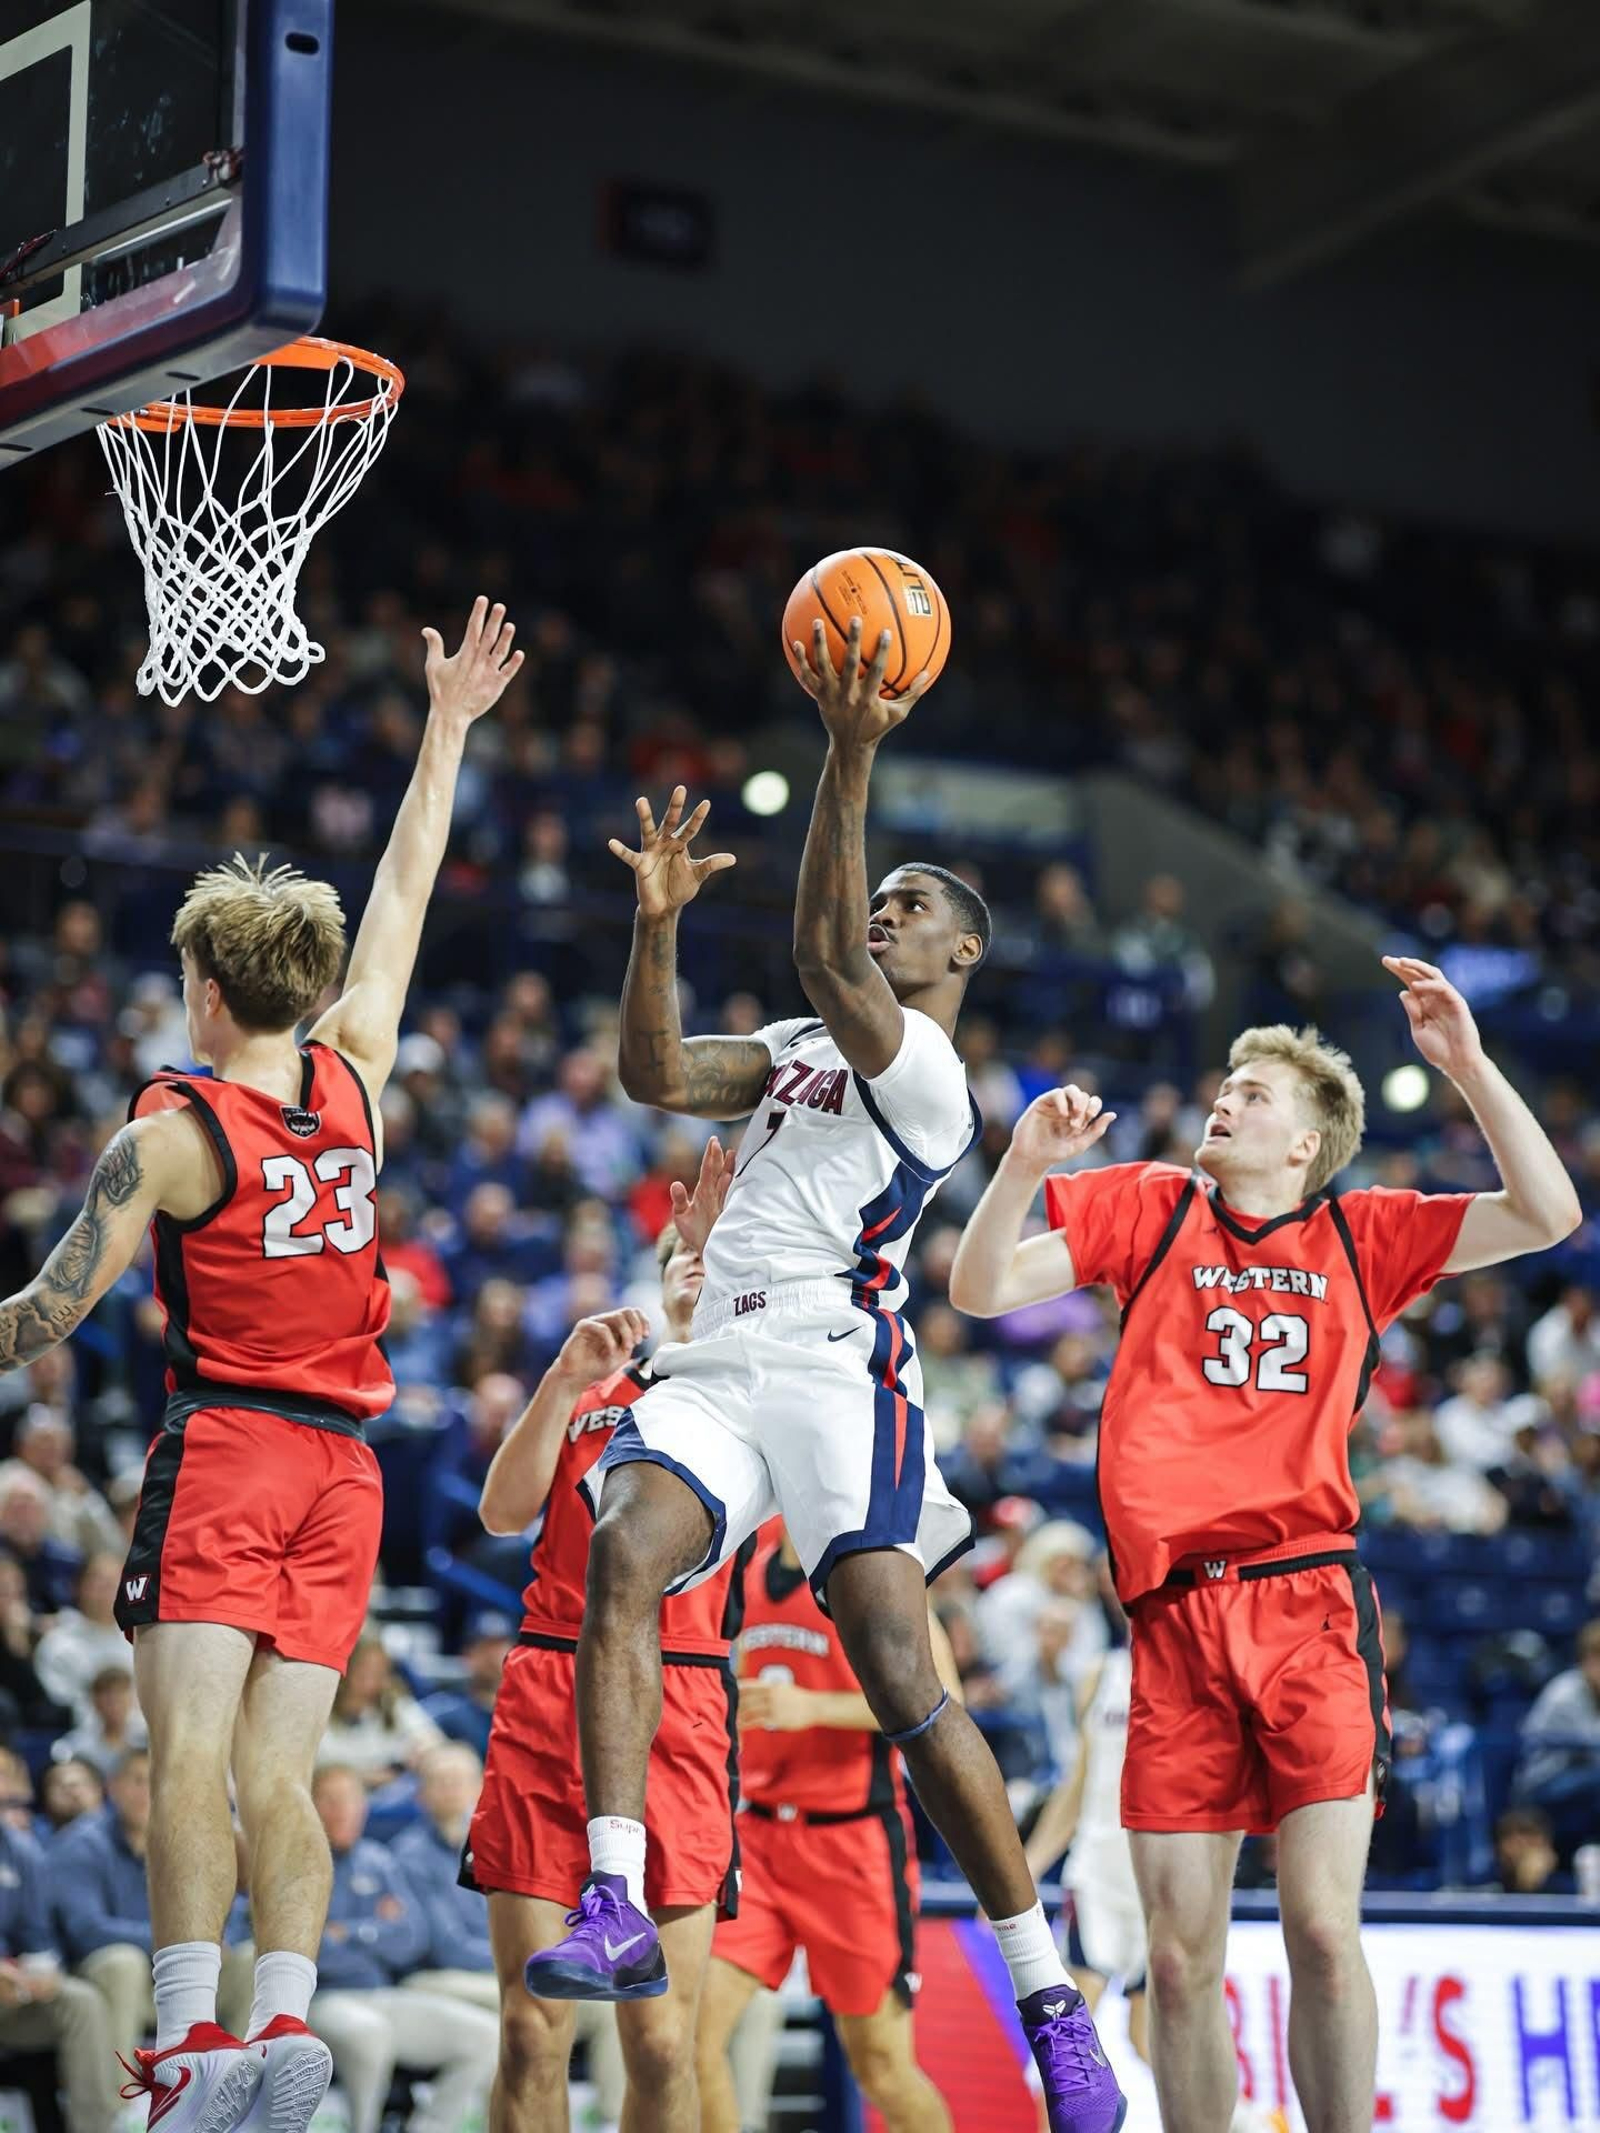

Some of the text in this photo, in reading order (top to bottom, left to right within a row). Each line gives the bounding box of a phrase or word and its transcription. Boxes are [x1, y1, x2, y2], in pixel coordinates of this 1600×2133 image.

[261, 1145, 377, 1259] 23
[1192, 1264, 1329, 1301] WESTERN
[733, 1291, 767, 1317] ZAGS
[1202, 1305, 1310, 1395] 32
[1203, 1560, 1227, 1579] W
[125, 1576, 148, 1602] W
